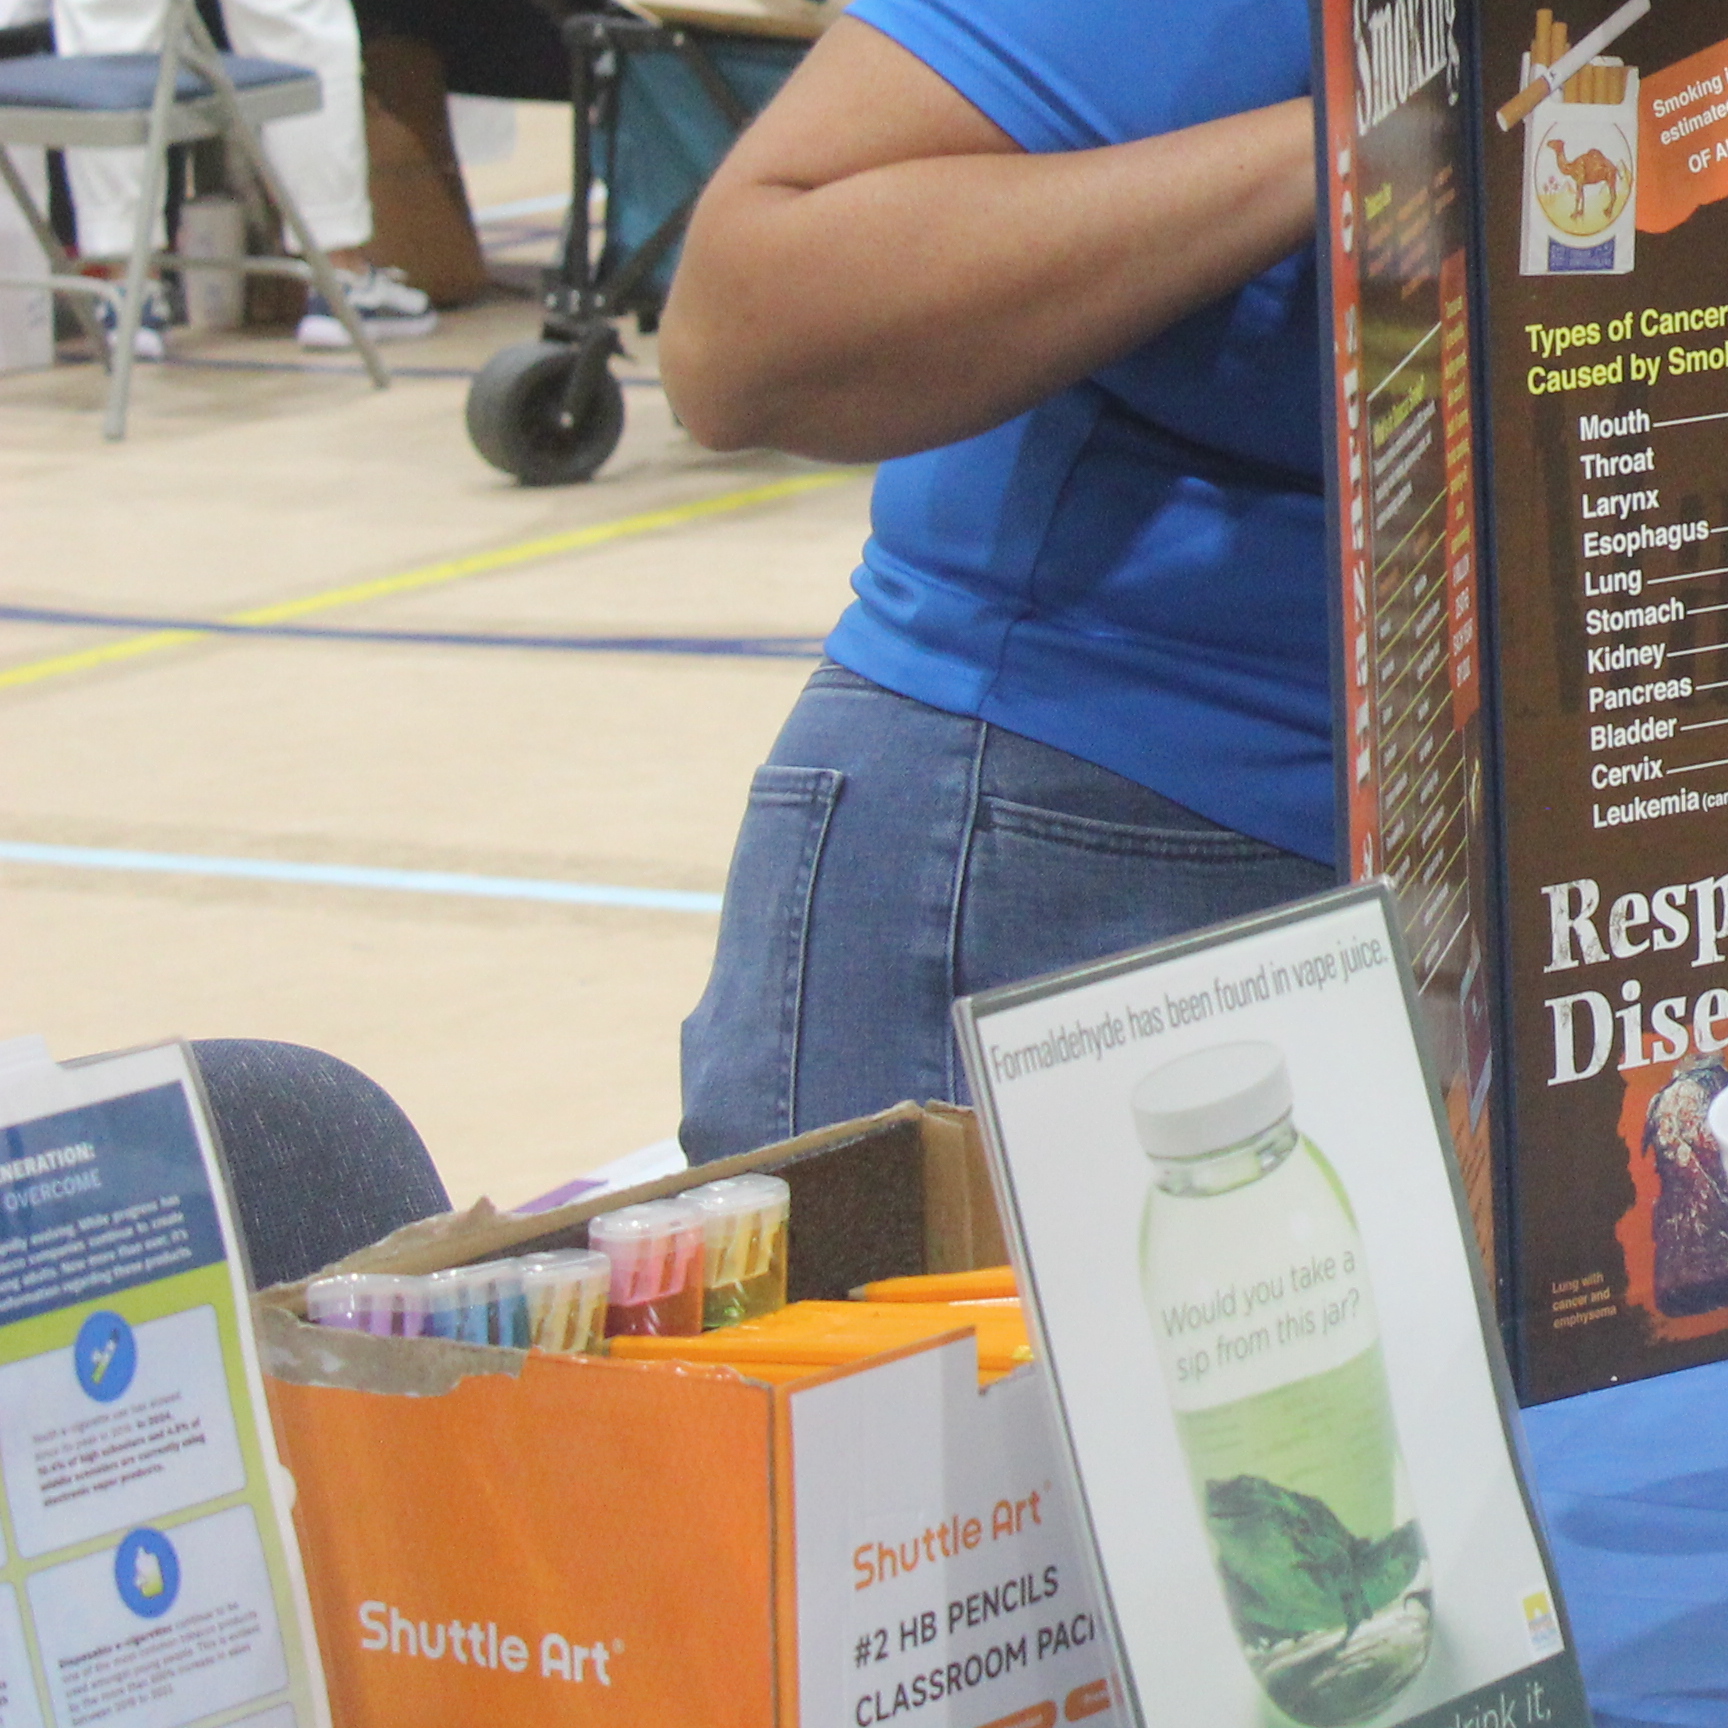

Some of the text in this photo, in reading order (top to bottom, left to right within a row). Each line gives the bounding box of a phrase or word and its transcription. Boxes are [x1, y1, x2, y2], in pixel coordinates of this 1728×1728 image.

[1652, 76, 1723, 118] Smoking
[1688, 149, 1713, 174] OF
[1525, 321, 1601, 358] Types
[1608, 310, 1634, 341] of
[1527, 356, 1625, 395] Caused
[1630, 349, 1662, 386] by
[1578, 408, 1651, 442] Mouth
[1580, 446, 1656, 481] Throat
[1582, 486, 1661, 520] Larynx
[1583, 517, 1710, 559] Esophagus
[1585, 568, 1643, 597] Lung
[1585, 596, 1686, 636] Stomach
[1587, 640, 1667, 675] Kidney
[1588, 675, 1694, 713] Pancreas
[1590, 713, 1678, 752] Bladder
[1591, 754, 1664, 790] Cervix
[1592, 787, 1700, 830] Leukemia
[990, 935, 1389, 1085] Formaldehyde has been found in vape juice.
[0, 1141, 96, 1184] NERATION:
[3, 1167, 102, 1211] OVERCOME
[1162, 1250, 1355, 1338] Would you take a
[1551, 1279, 1579, 1295] Lung
[1552, 1287, 1611, 1312] cancer and
[1177, 1287, 1360, 1382] sip from this jar?
[1553, 1305, 1617, 1329] emphysema
[852, 1514, 983, 1591] Shuttle
[358, 1600, 530, 1673] Shuttle
[855, 1565, 1060, 1669] #2 HB PENCILS
[855, 1634, 1027, 1728] CLASSROOM
